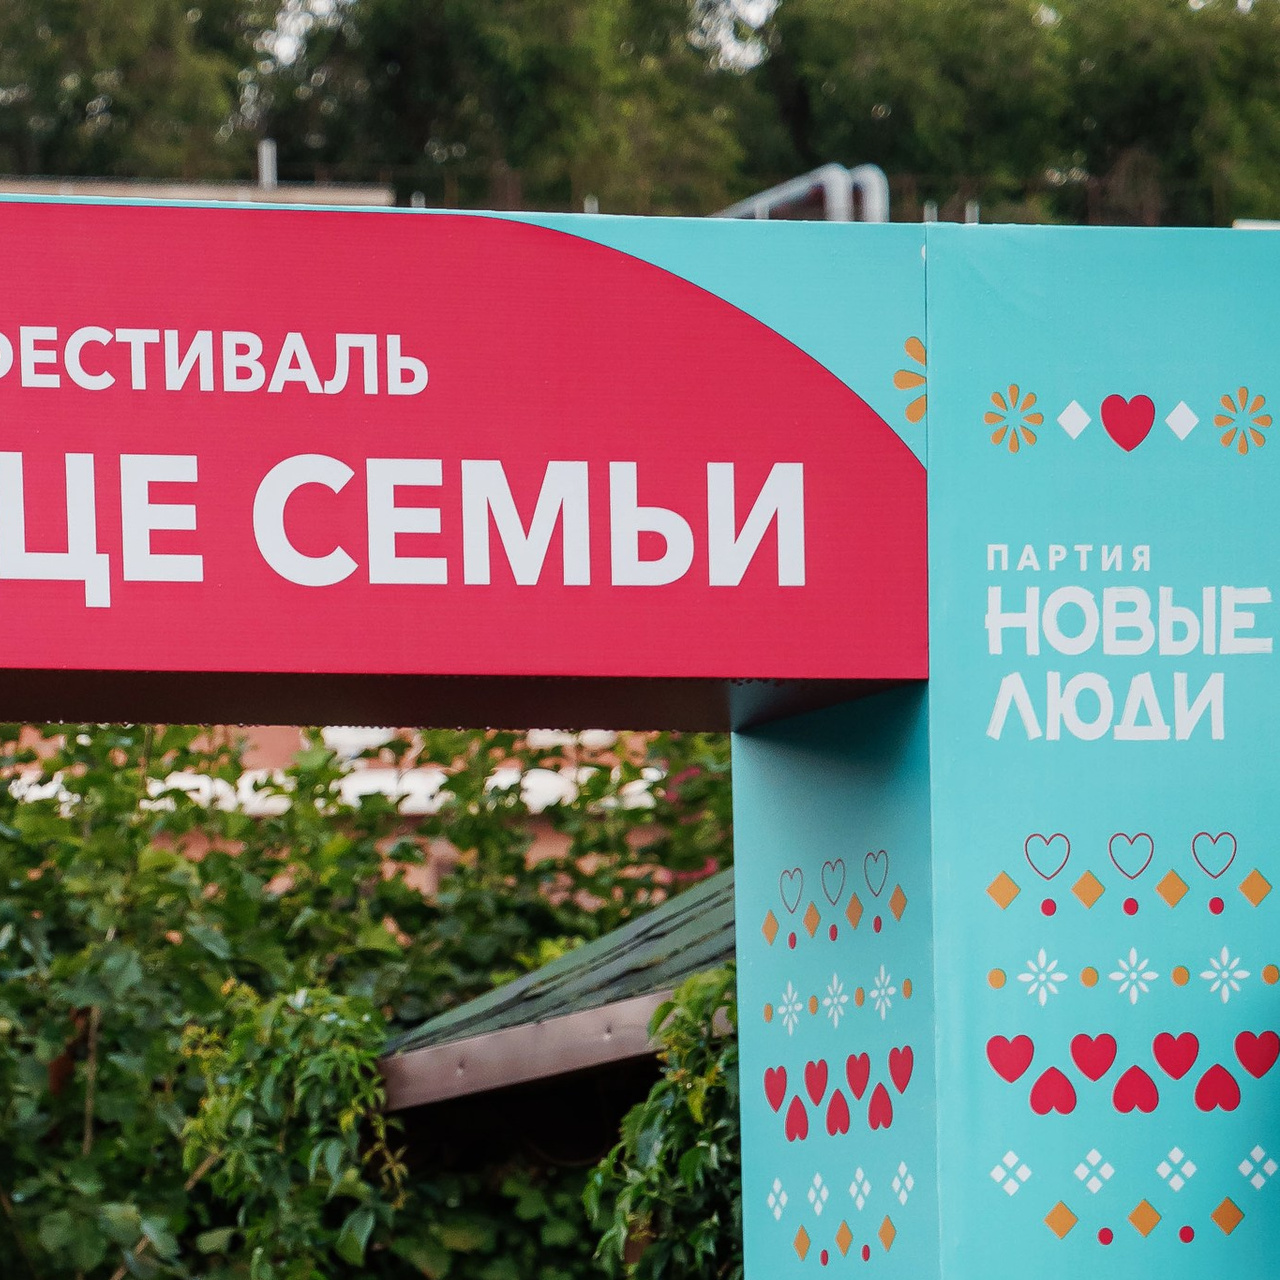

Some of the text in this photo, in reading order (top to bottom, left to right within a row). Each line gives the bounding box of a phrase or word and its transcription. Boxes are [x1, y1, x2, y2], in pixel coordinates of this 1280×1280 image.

[252, 453, 806, 587] СЕМЬИ
[986, 544, 1151, 572] ПАРТИЯ
[984, 585, 1274, 657] НОВЫЕ
[986, 671, 1225, 742] ЛЮДИ
